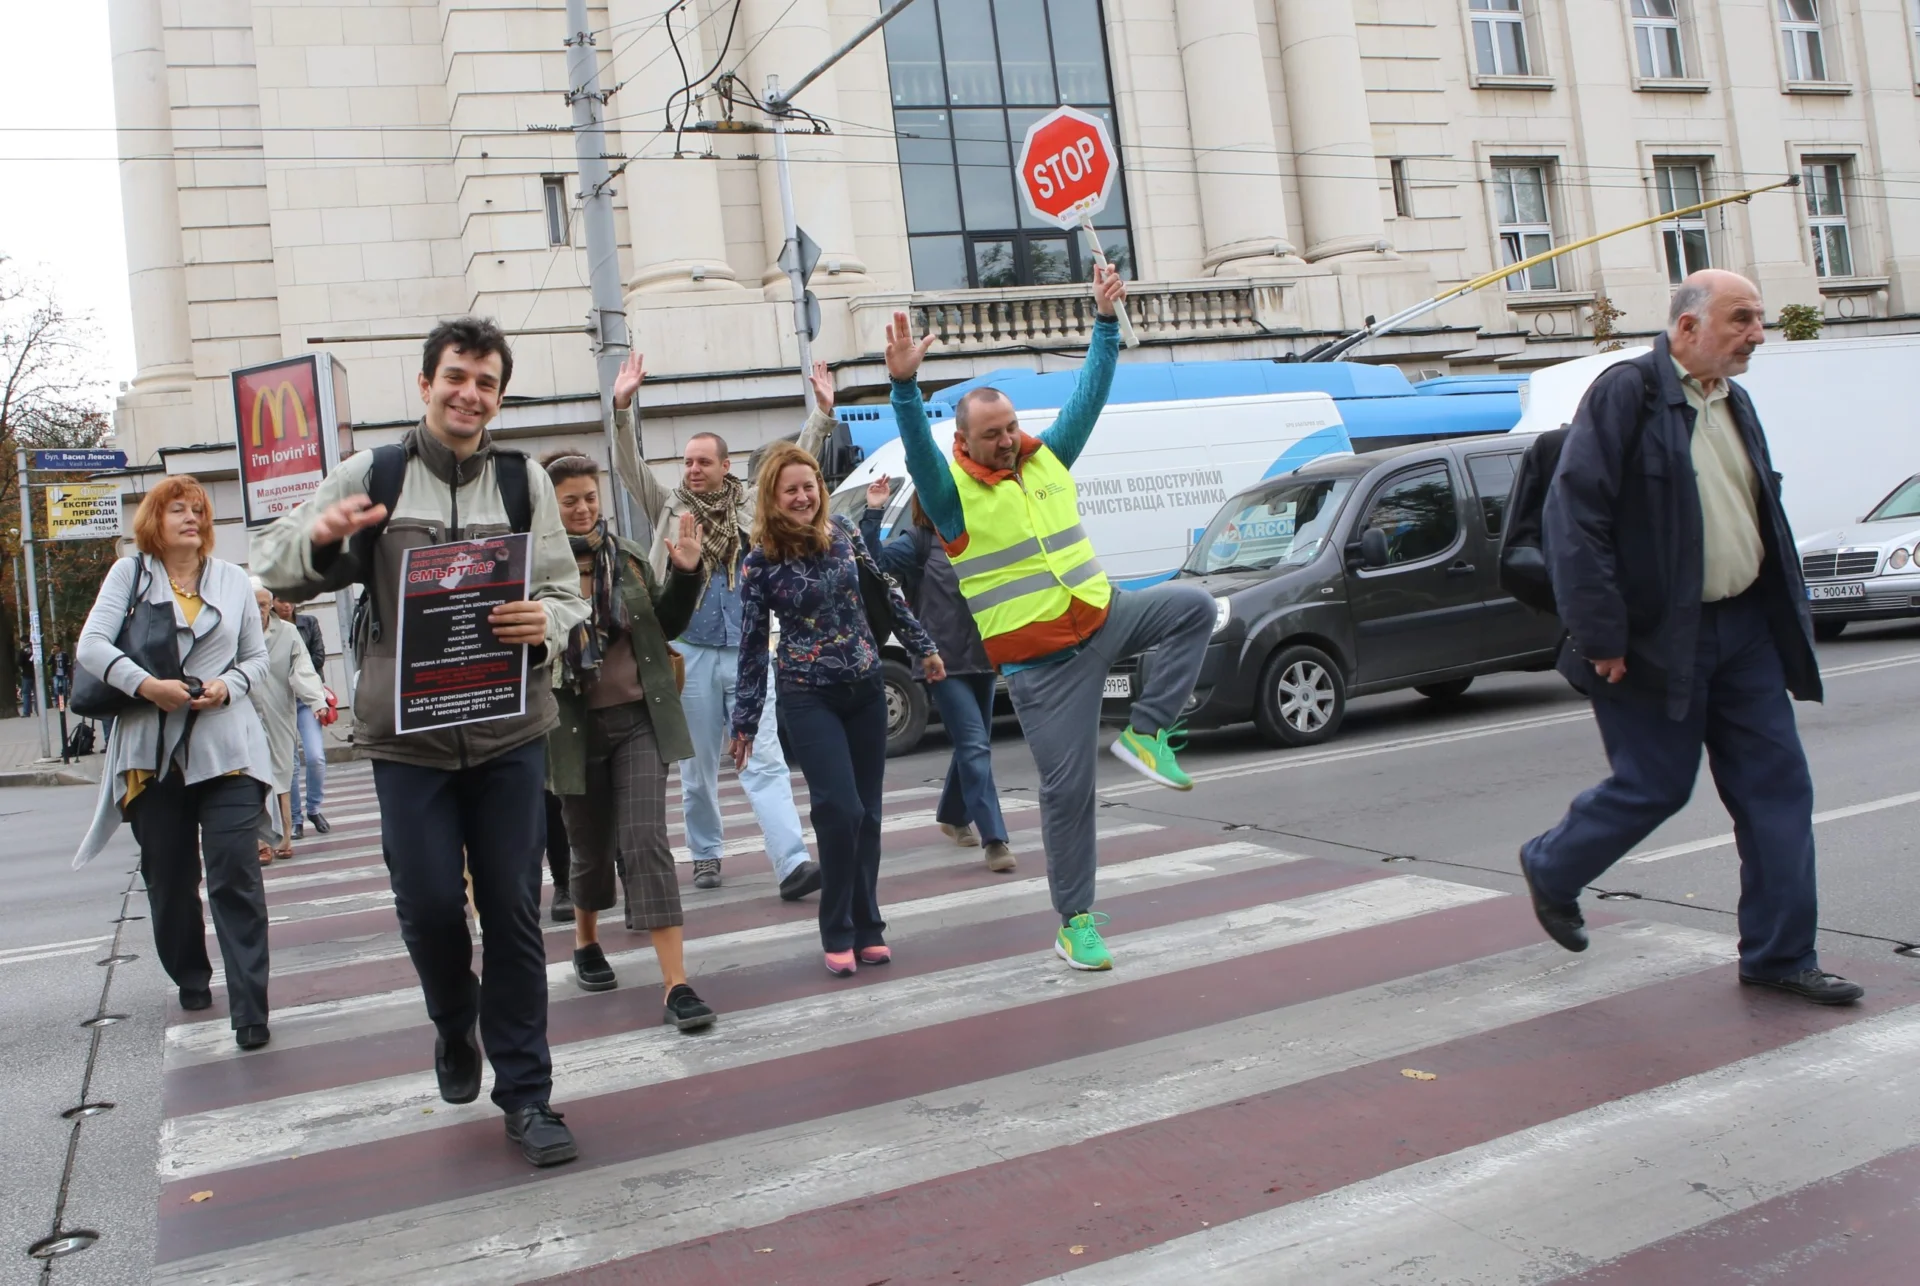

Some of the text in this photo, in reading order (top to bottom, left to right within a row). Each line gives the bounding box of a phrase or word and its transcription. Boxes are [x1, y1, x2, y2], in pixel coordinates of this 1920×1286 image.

[1033, 136, 1095, 199] STOP
[44, 453, 59, 461] бул.
[1126, 469, 1224, 493] ВОДОСТРУЙКИ
[256, 480, 320, 498] Макдоналдс
[63, 500, 117, 508] ЕКСПРЕСНИ
[1167, 488, 1228, 508] ТЕХНИКА
[268, 502, 283, 513] 150
[52, 517, 118, 526] ЛЕГАЛИЗАЦИИ
[408, 560, 496, 583] СМЪРТТА?
[452, 613, 476, 621] КОНТРОЛ
[434, 699, 471, 710] пешеходци
[471, 696, 487, 704] през
[487, 692, 515, 702] първите
[437, 708, 461, 716] месеца
